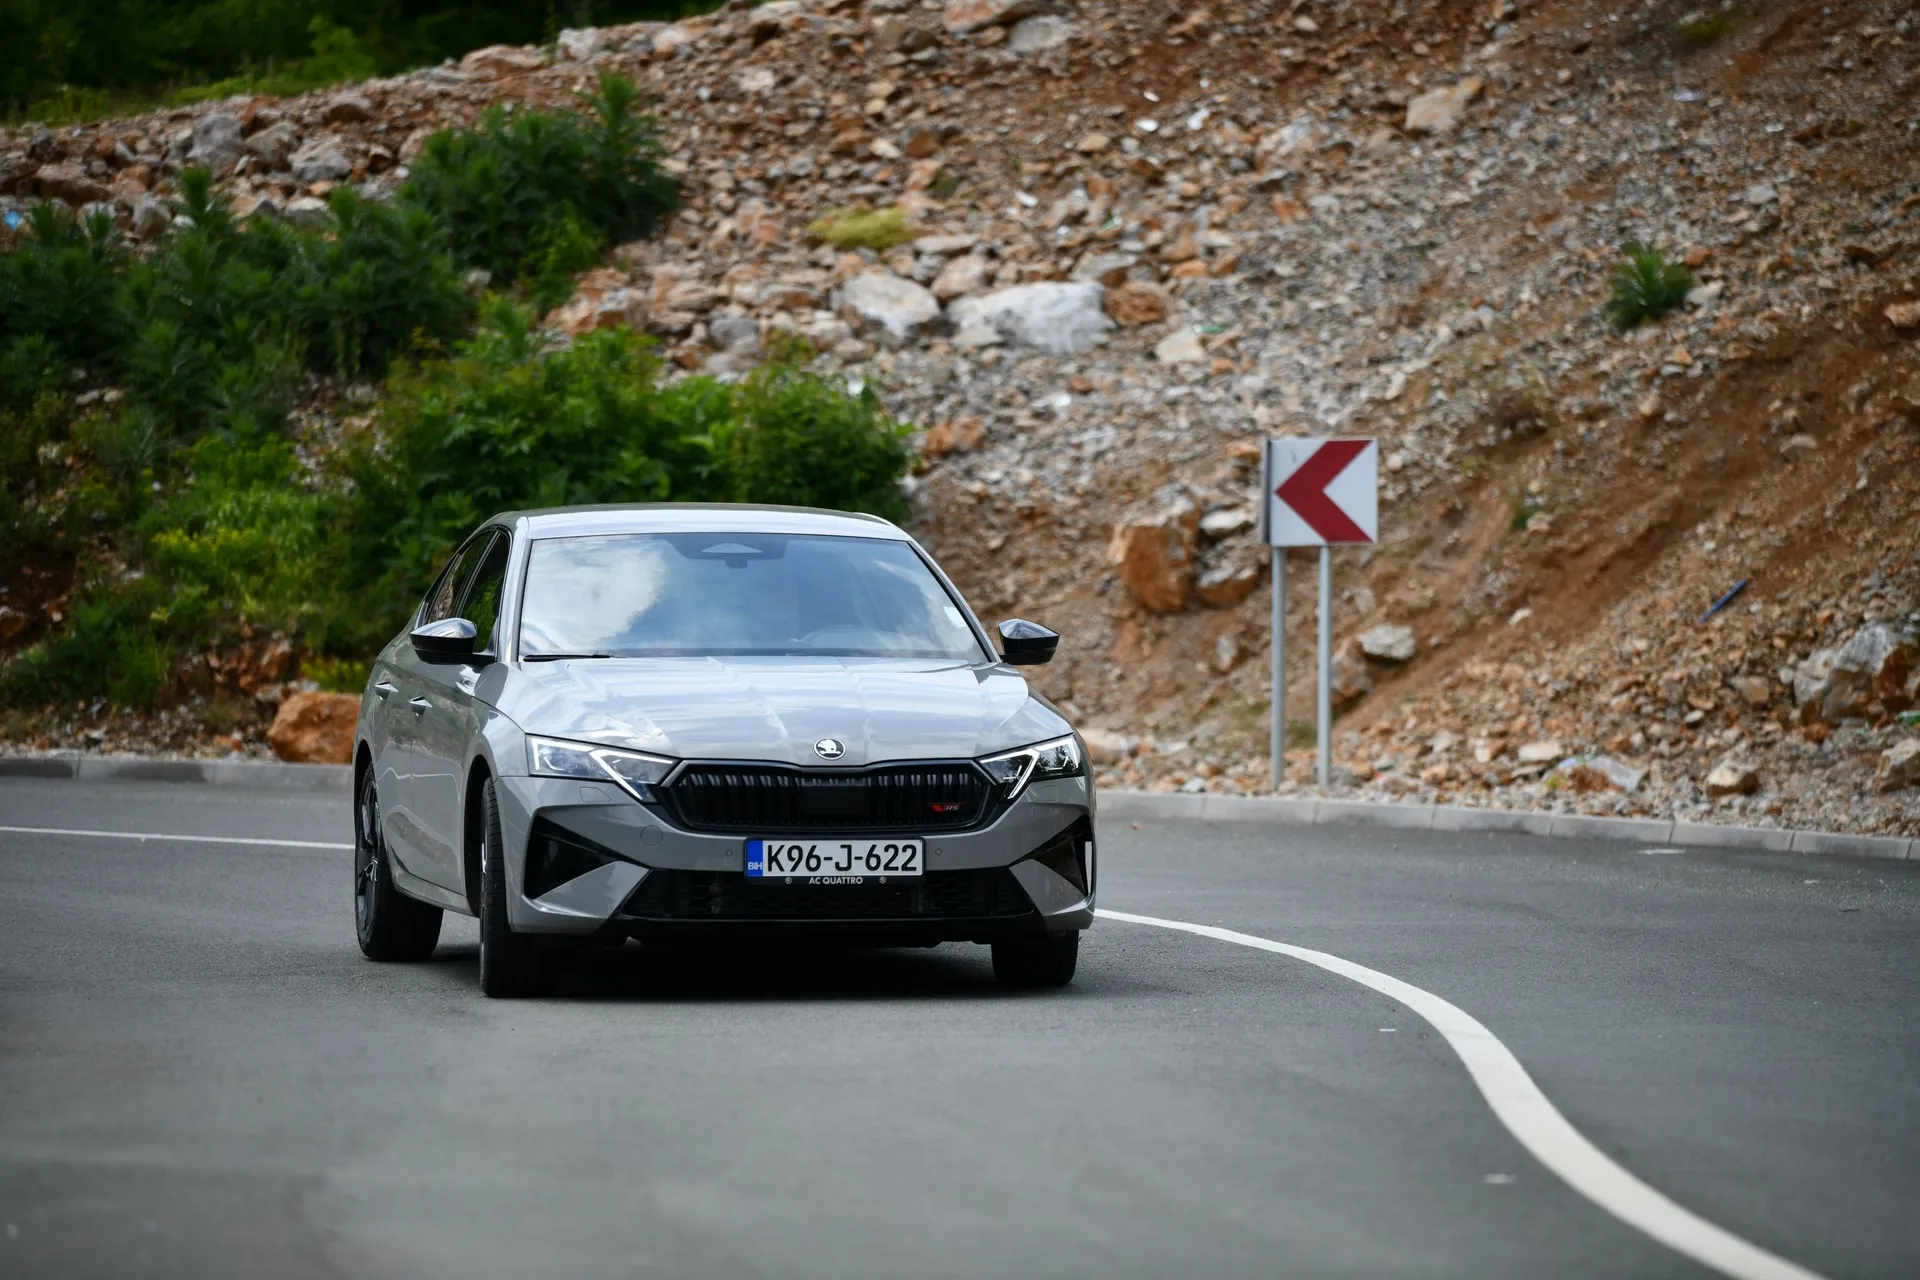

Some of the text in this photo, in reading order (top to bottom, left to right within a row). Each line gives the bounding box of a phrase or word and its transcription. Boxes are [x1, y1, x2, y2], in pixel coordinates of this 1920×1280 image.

[767, 844, 918, 872] K96-J-622
[747, 862, 763, 870] BIH
[808, 876, 863, 885] AC QUATTRO
